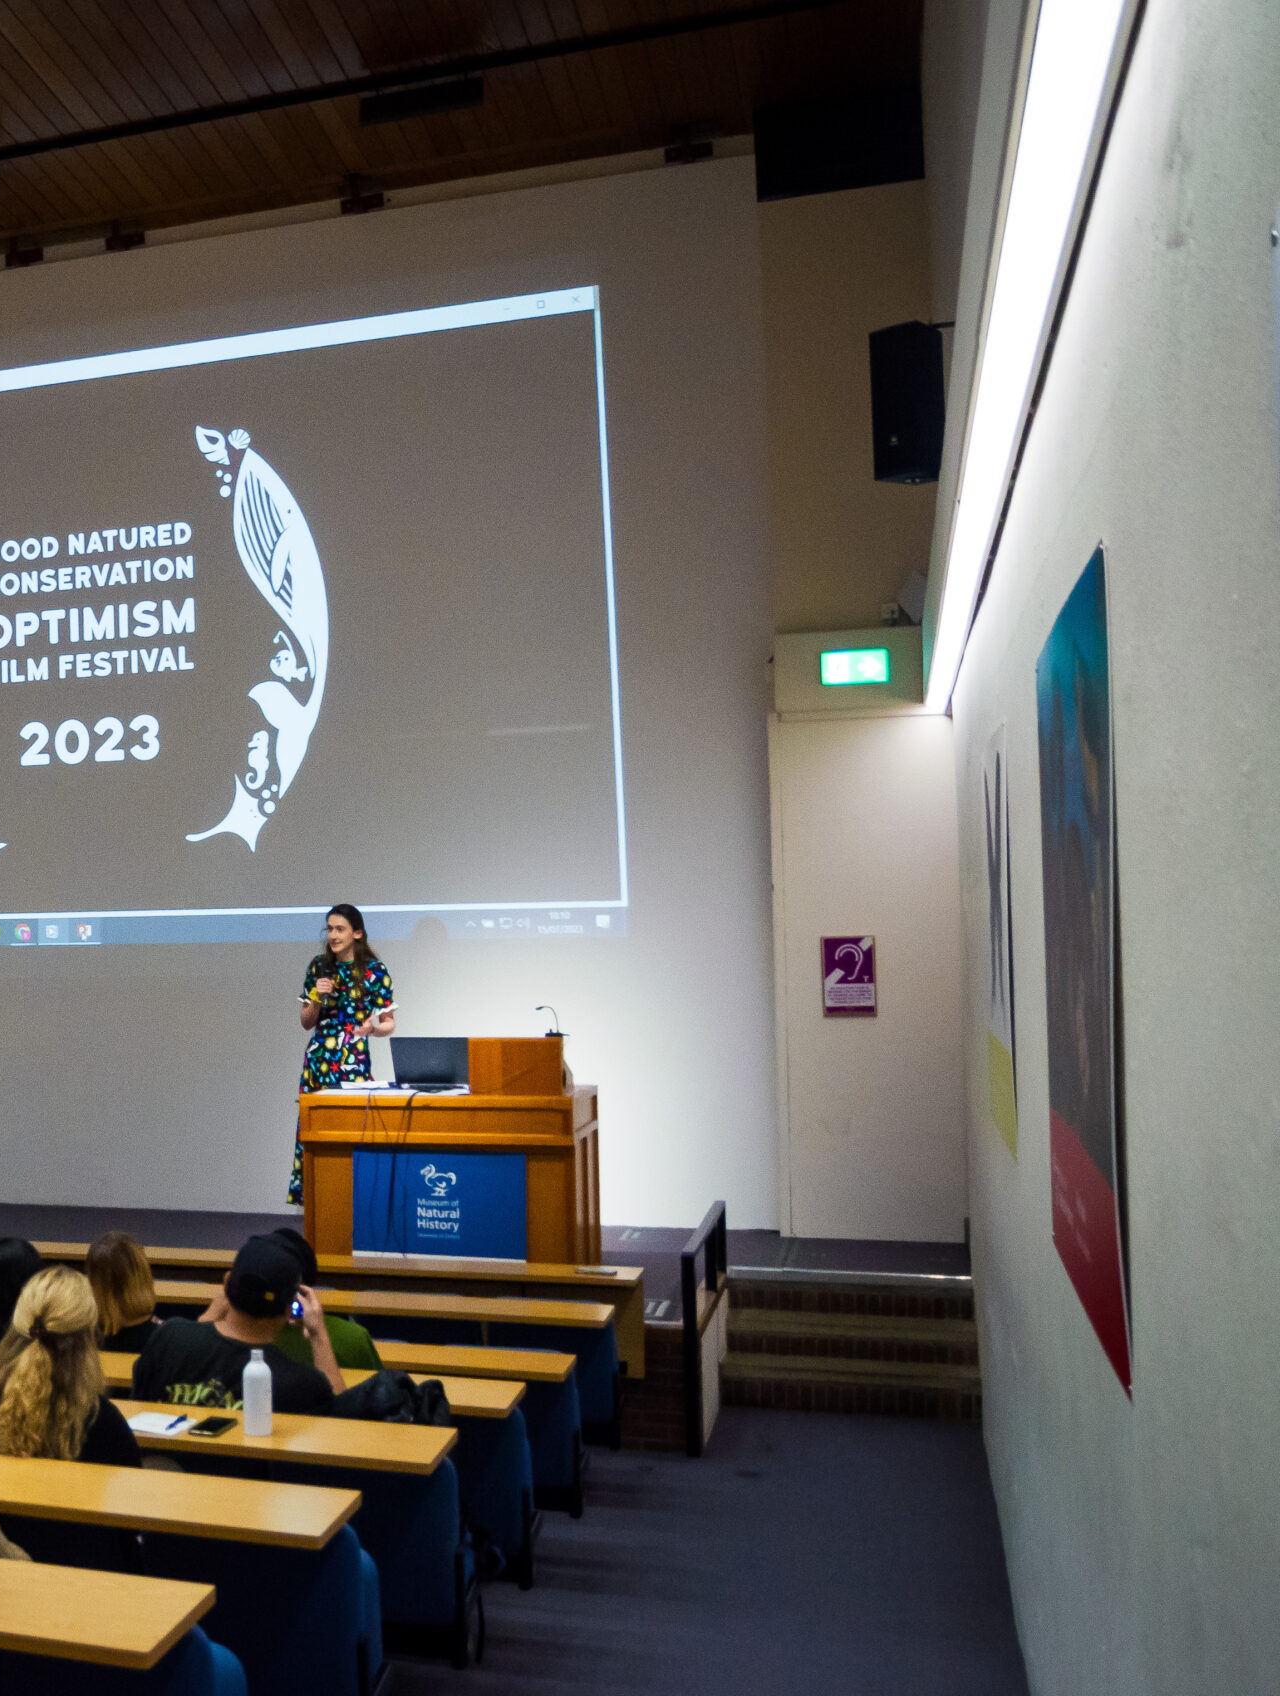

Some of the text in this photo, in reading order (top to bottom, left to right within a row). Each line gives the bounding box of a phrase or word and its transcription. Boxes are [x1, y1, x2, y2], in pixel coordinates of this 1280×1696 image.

[68, 521, 192, 555] NATURED
[58, 645, 195, 679] FESTIVAL
[19, 714, 160, 766] 2023
[417, 1198, 459, 1207] Museum of
[417, 1206, 460, 1219] Natural
[417, 1218, 459, 1233] History
